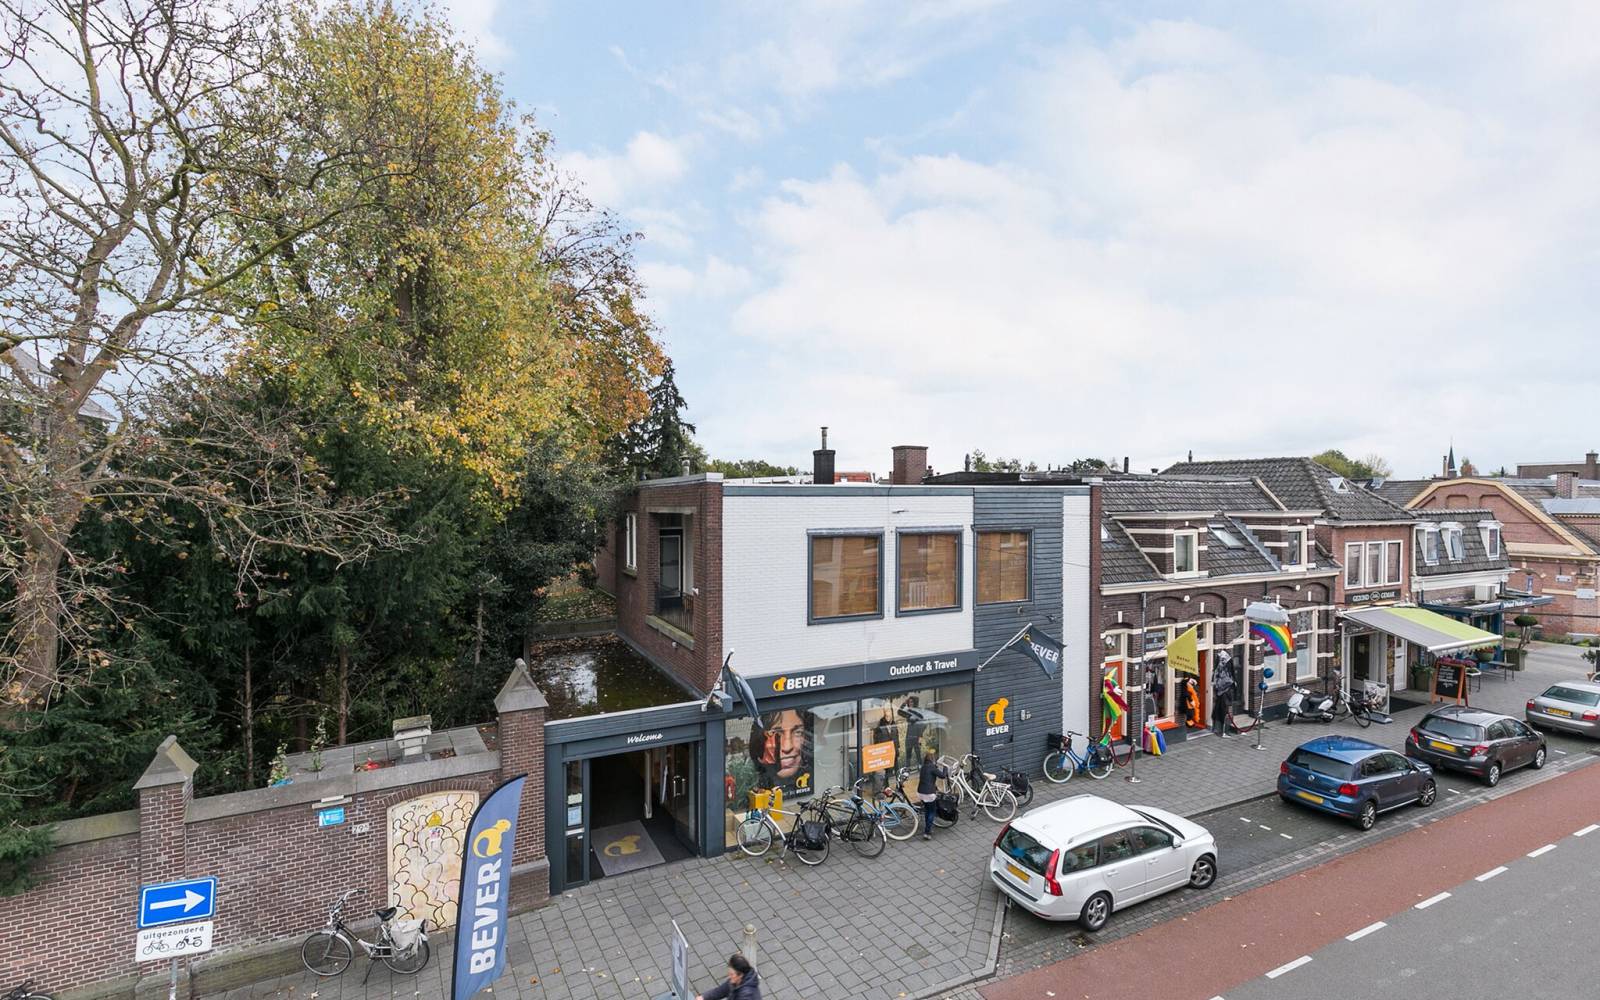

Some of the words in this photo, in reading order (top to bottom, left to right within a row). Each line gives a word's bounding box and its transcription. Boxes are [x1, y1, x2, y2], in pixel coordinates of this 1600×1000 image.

[889, 662, 924, 677] Outdoor
[925, 661, 933, 672] &
[934, 658, 958, 670] Travel
[786, 674, 825, 690] BEVER
[986, 724, 1009, 736] BEVER
[626, 732, 664, 745] Welcome
[469, 858, 502, 975] BEVER
[143, 925, 204, 940] uitgezonderd
